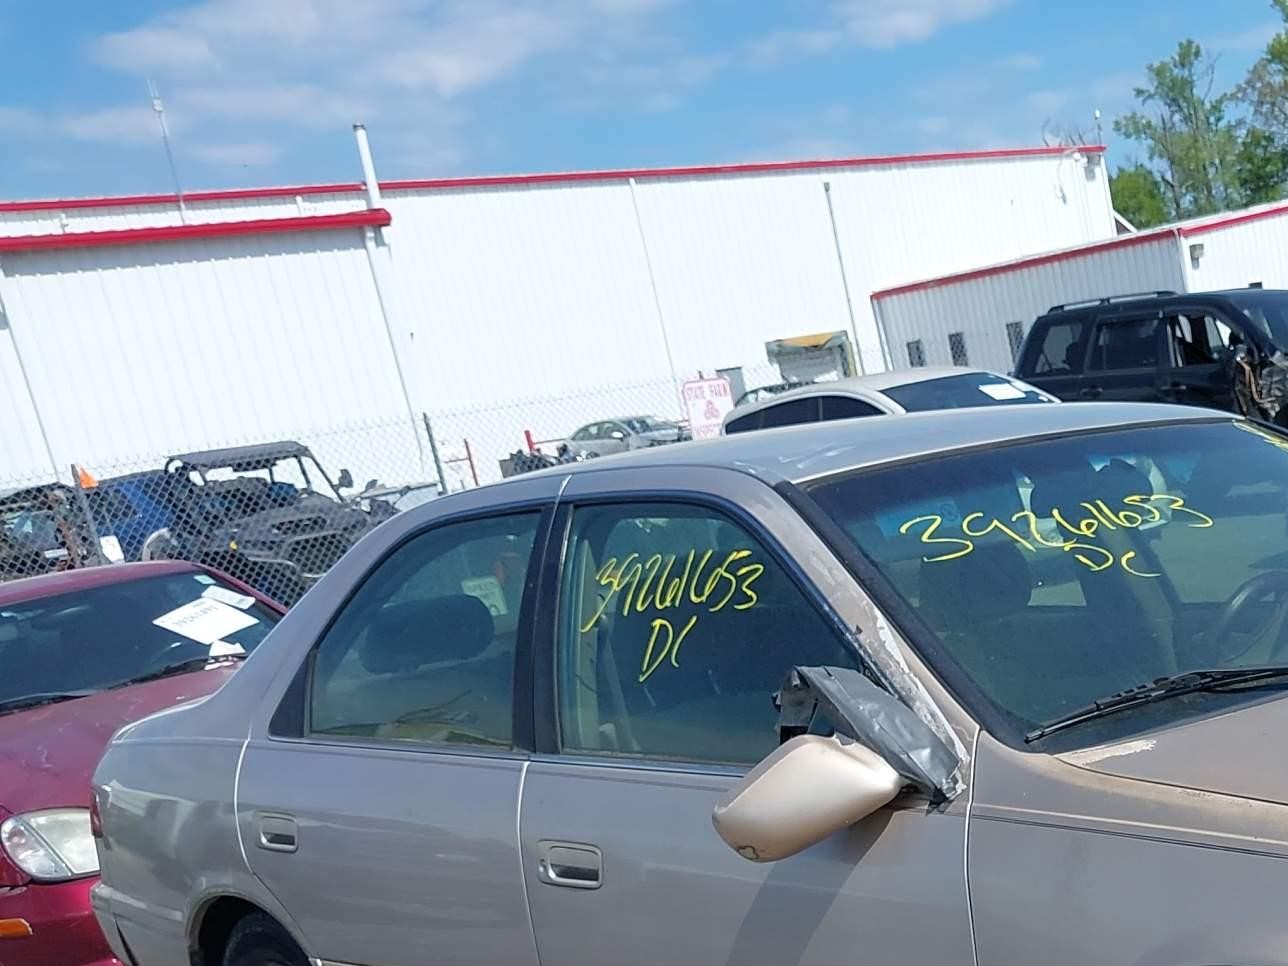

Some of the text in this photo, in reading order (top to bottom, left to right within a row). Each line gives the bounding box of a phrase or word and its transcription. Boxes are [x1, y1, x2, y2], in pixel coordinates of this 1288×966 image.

[898, 493, 1214, 563] 39261653
[1064, 541, 1162, 578] DC
[580, 549, 766, 634] 39261653
